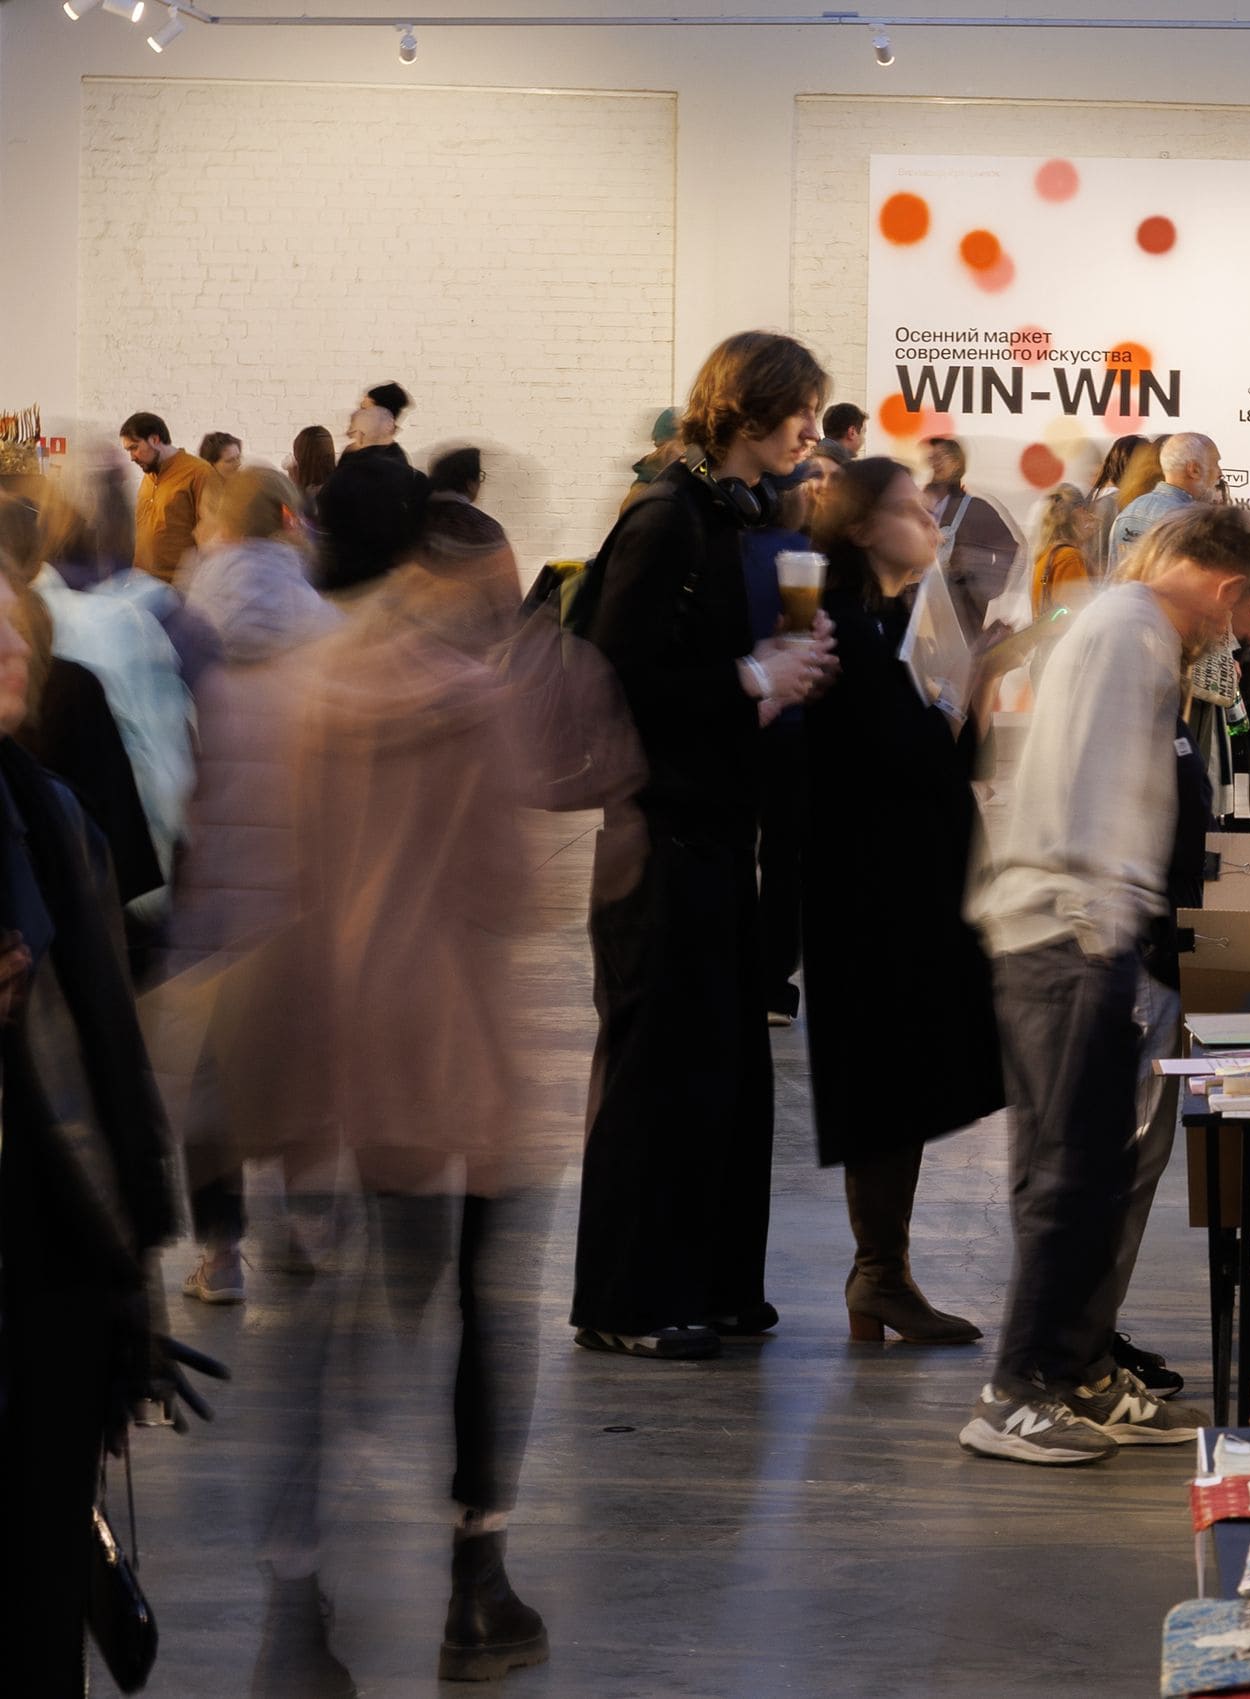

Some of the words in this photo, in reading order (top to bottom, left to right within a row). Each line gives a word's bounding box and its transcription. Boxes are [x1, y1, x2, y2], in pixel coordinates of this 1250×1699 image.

[895, 327, 979, 343] Осенний
[984, 330, 1053, 348] маркет
[895, 346, 1032, 363] современного
[1037, 350, 1132, 365] искусства
[896, 365, 1181, 417] WIN-WIN
[1219, 654, 1228, 697] DUBLIN
